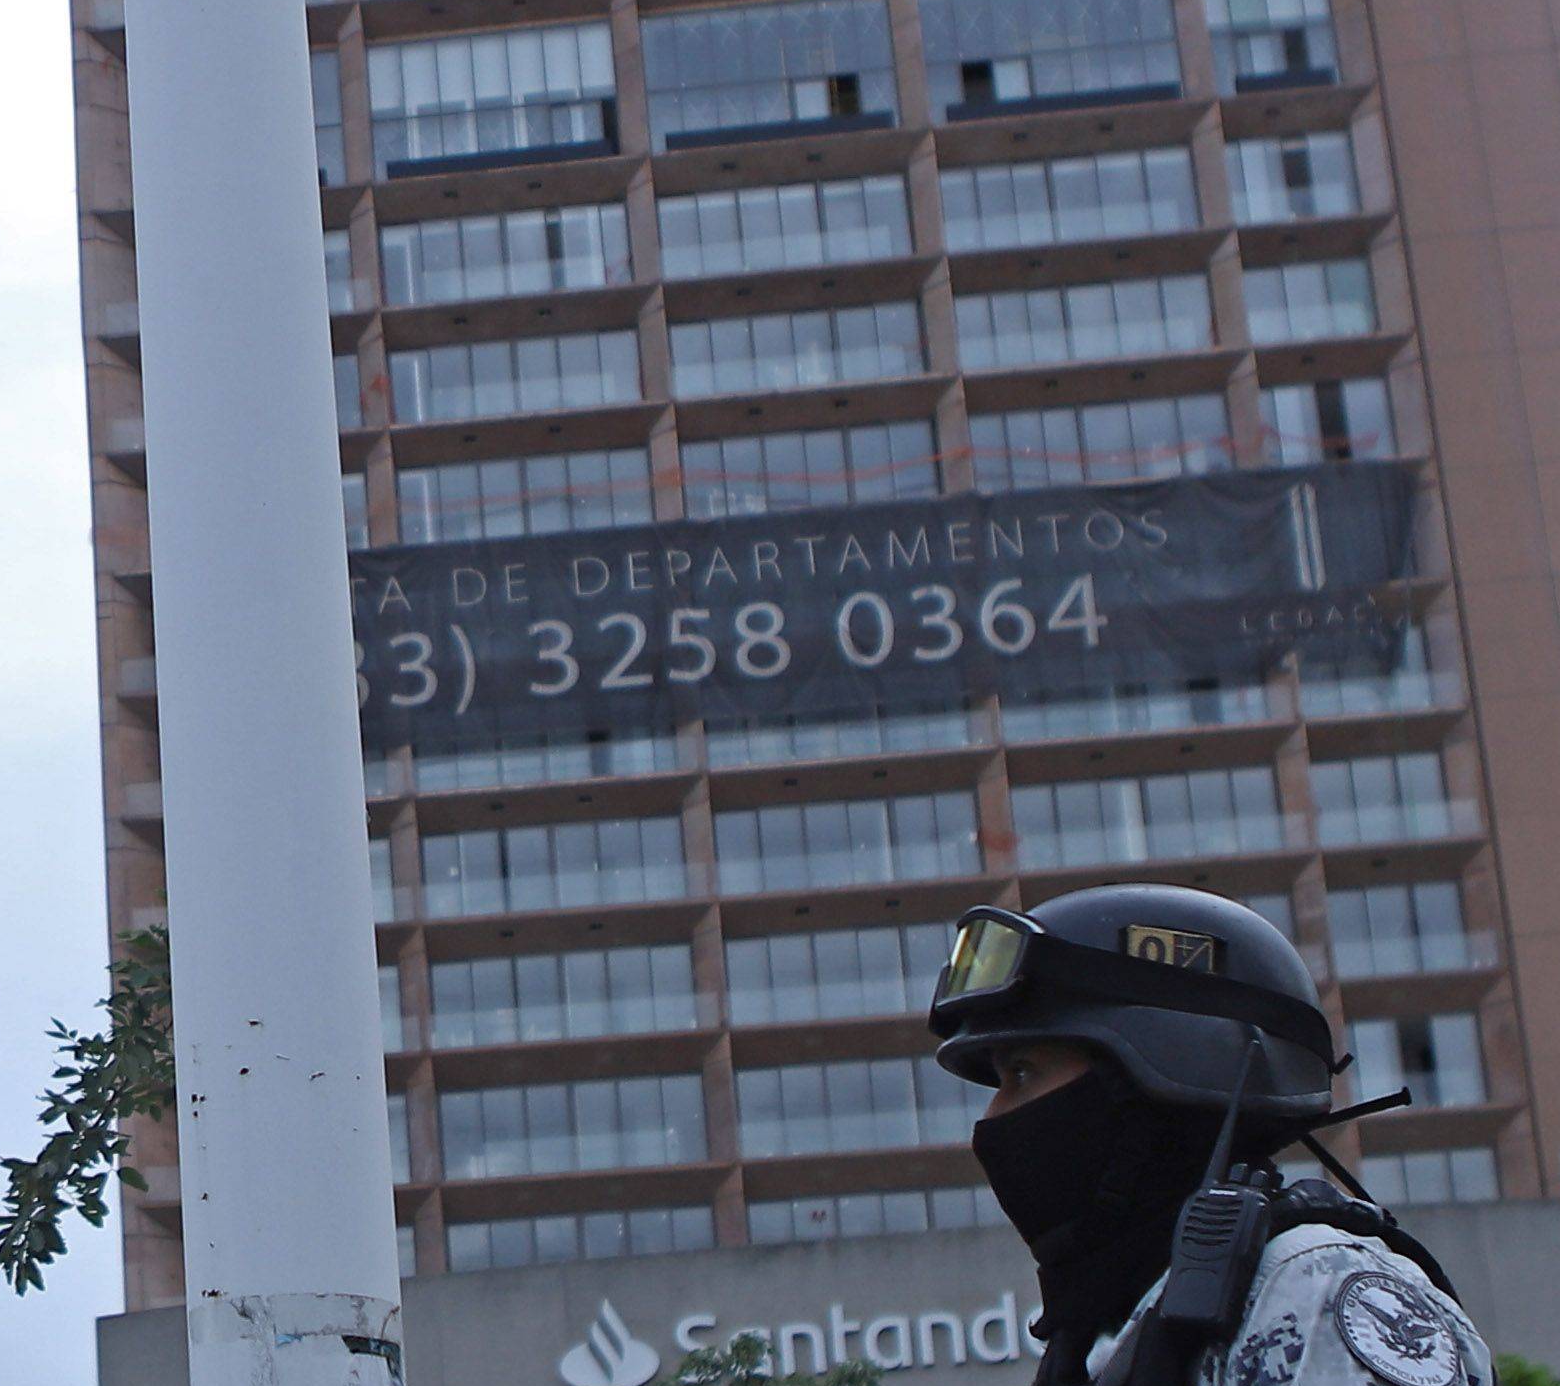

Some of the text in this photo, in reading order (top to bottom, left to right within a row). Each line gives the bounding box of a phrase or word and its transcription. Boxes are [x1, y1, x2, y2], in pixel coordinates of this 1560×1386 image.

[452, 562, 531, 608] DE
[572, 509, 1170, 597] DEPARTAMENTOS
[528, 601, 792, 696] 3258
[836, 570, 1109, 668] 0364
